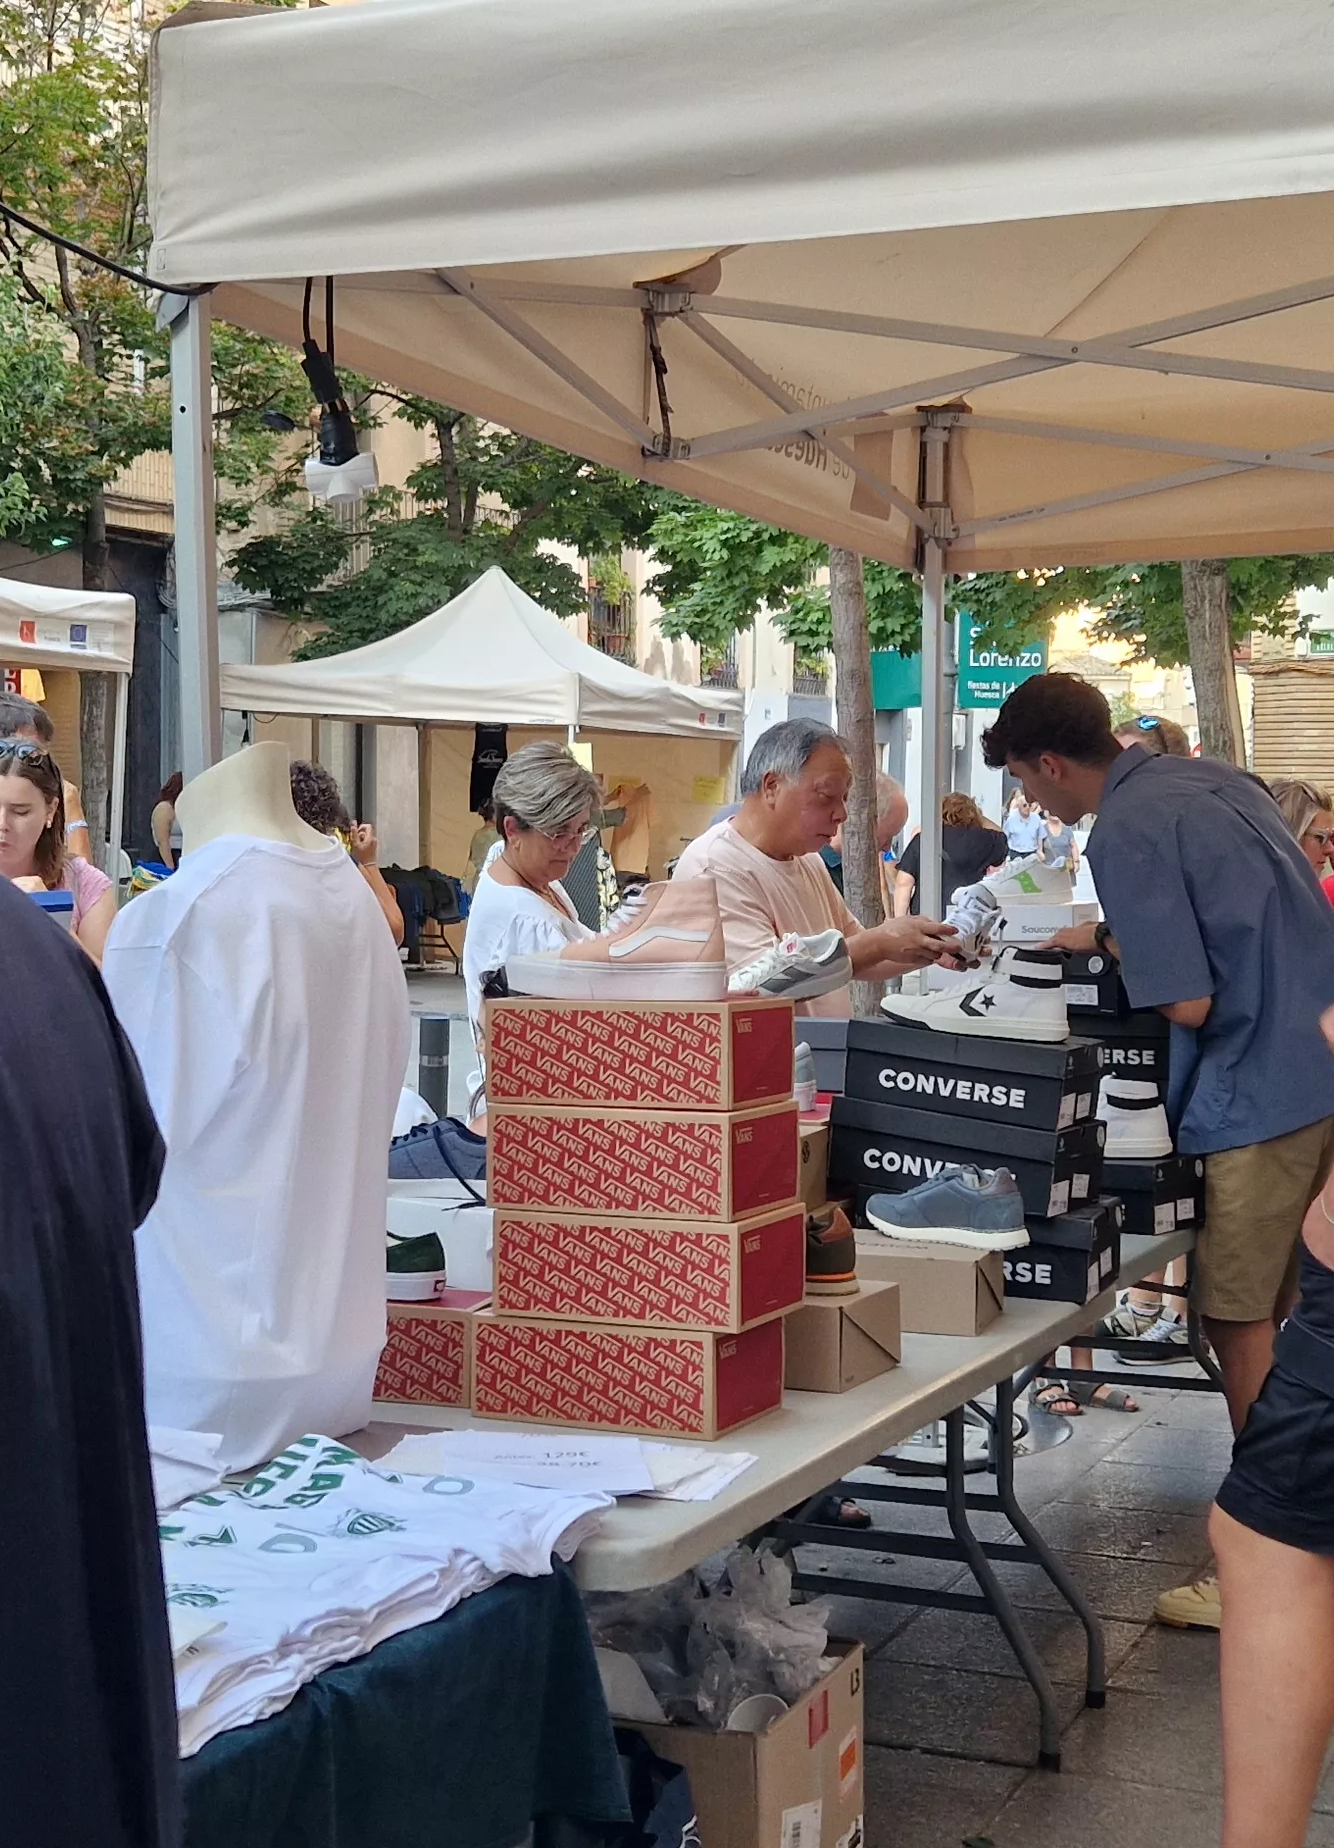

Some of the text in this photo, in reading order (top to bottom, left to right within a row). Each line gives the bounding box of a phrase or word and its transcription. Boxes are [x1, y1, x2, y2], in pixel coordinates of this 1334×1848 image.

[499, 1031, 535, 1061] VANS
[536, 1051, 572, 1081] VANS
[551, 1017, 586, 1048] VANS
[588, 1037, 624, 1068] VANS
[625, 1058, 661, 1088] VANS
[577, 1011, 613, 1041] VANS
[614, 1031, 650, 1061] VANS
[651, 1051, 688, 1082] VANS
[640, 1024, 676, 1054] VANS
[678, 1044, 715, 1075] VANS
[666, 1016, 703, 1047] VANS
[1104, 1048, 1155, 1066] ERSE
[511, 1058, 547, 1088] VANS
[526, 1024, 561, 1055] VANS
[562, 1044, 597, 1075] VANS
[599, 1065, 635, 1095] VANS
[878, 1068, 1026, 1109] CONVERSE
[578, 1119, 614, 1150] VANS
[615, 1140, 651, 1171] VANS
[652, 1161, 689, 1193] VANS
[641, 1133, 677, 1164] VANS
[679, 1154, 717, 1186] VANS
[667, 1126, 704, 1158] VANS
[734, 1126, 753, 1144] VANS
[501, 1137, 537, 1168] VANS
[538, 1158, 573, 1189] VANS
[513, 1165, 548, 1195] VANS
[528, 1131, 562, 1162] VANS
[563, 1152, 598, 1183] VANS
[600, 1174, 636, 1204] VANS
[552, 1125, 587, 1156] VANS
[589, 1145, 625, 1177] VANS
[626, 1167, 662, 1198] VANS
[506, 1243, 543, 1275] VANS
[544, 1265, 580, 1297] VANS
[534, 1237, 569, 1270] VANS
[570, 1259, 605, 1292] VANS
[607, 1282, 644, 1314] VANS
[559, 1231, 594, 1264] VANS
[596, 1253, 633, 1286] VANS
[634, 1276, 670, 1308] VANS
[585, 1226, 622, 1258] VANS
[623, 1248, 659, 1280] VANS
[660, 1270, 697, 1303] VANS
[649, 1242, 685, 1274] VANS
[687, 1264, 724, 1297] VANS
[675, 1235, 712, 1268] VANS
[518, 1271, 555, 1303] VANS
[388, 1330, 457, 1378] ANS VANS
[411, 1320, 446, 1351] VANS
[649, 1341, 686, 1374] VANS
[719, 1339, 738, 1359] VANS
[378, 1362, 406, 1389] ANS
[395, 1352, 432, 1383] VANS
[484, 1346, 519, 1377] VANS
[520, 1368, 556, 1400] VANS
[496, 1374, 531, 1405] VANS
[510, 1340, 545, 1373] VANS
[546, 1363, 581, 1396] VANS
[583, 1386, 619, 1418] VANS
[535, 1335, 570, 1368] VANS
[572, 1358, 608, 1390] VANS
[609, 1381, 644, 1413] VANS
[561, 1331, 597, 1362] VANS
[598, 1353, 633, 1385] VANS
[634, 1376, 671, 1408] VANS
[623, 1348, 659, 1379] VANS
[661, 1370, 698, 1403] VANS
